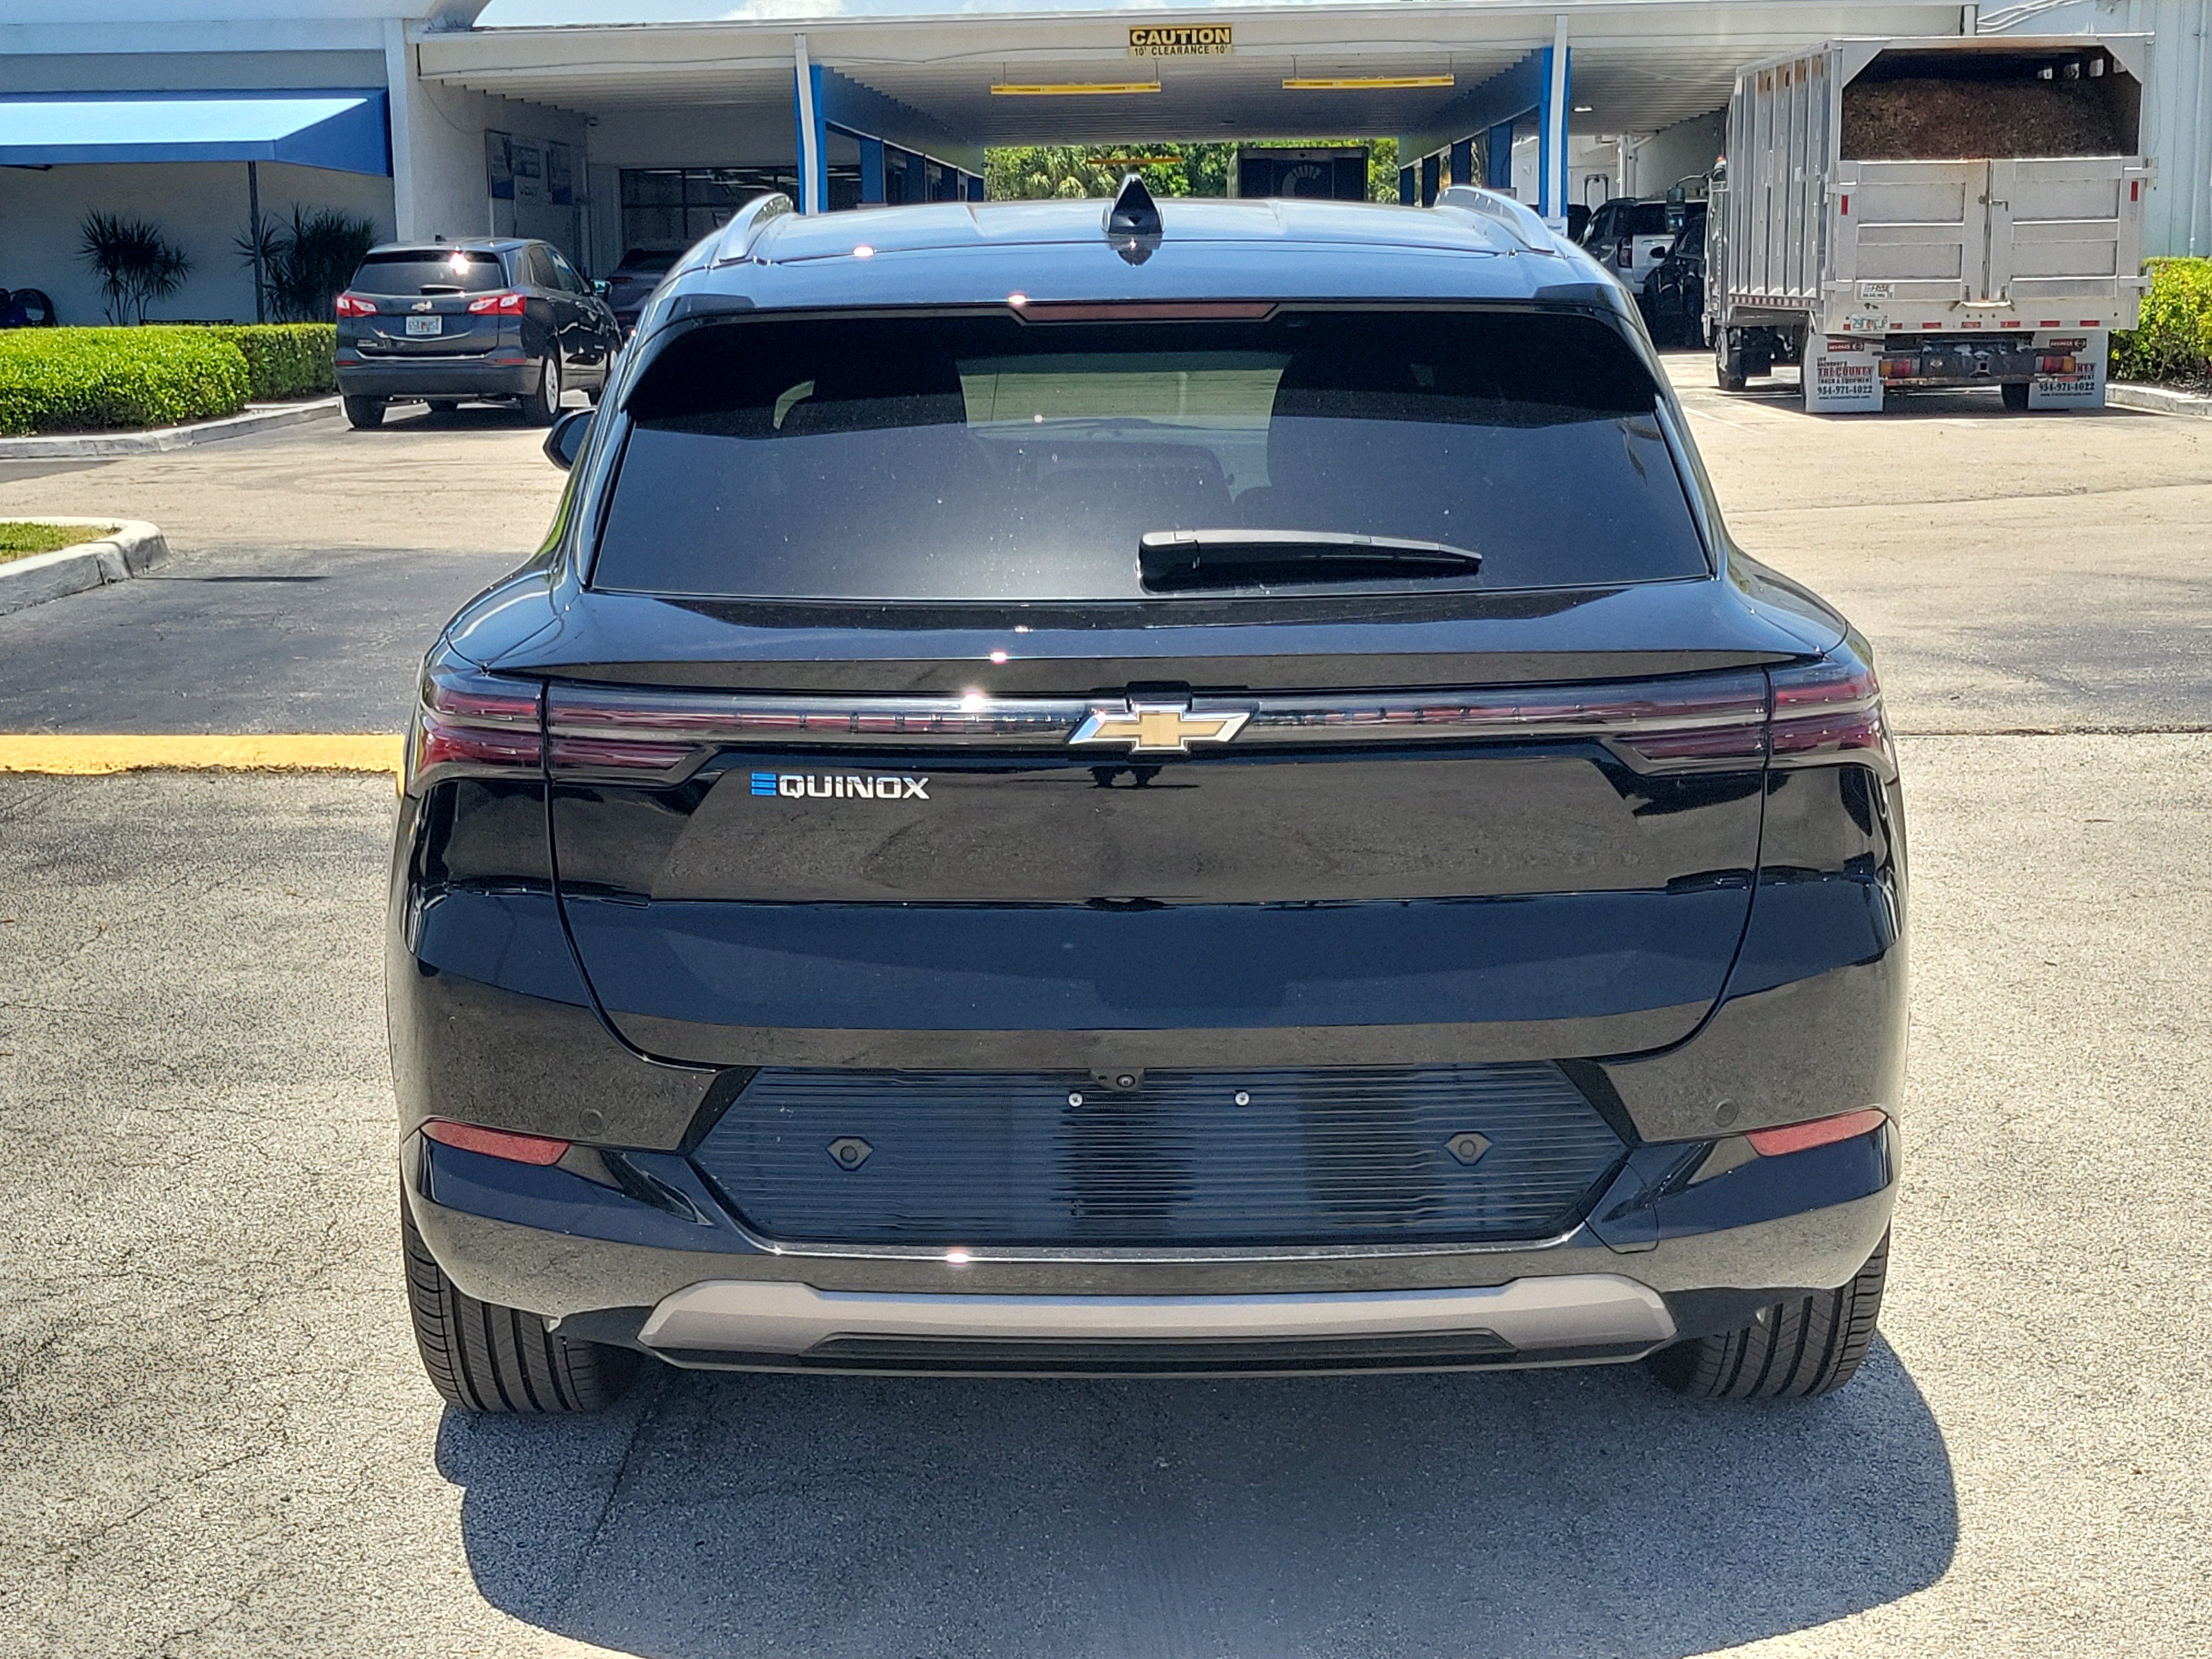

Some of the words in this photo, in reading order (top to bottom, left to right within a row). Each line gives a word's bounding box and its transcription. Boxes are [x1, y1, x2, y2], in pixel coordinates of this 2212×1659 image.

[1131, 29, 1230, 45] CAUTION
[1135, 48, 1147, 57] 10'
[1152, 46, 1209, 55] CLEARANCE
[1216, 46, 1228, 54] 10'
[751, 772, 930, 799] EQUINOX
